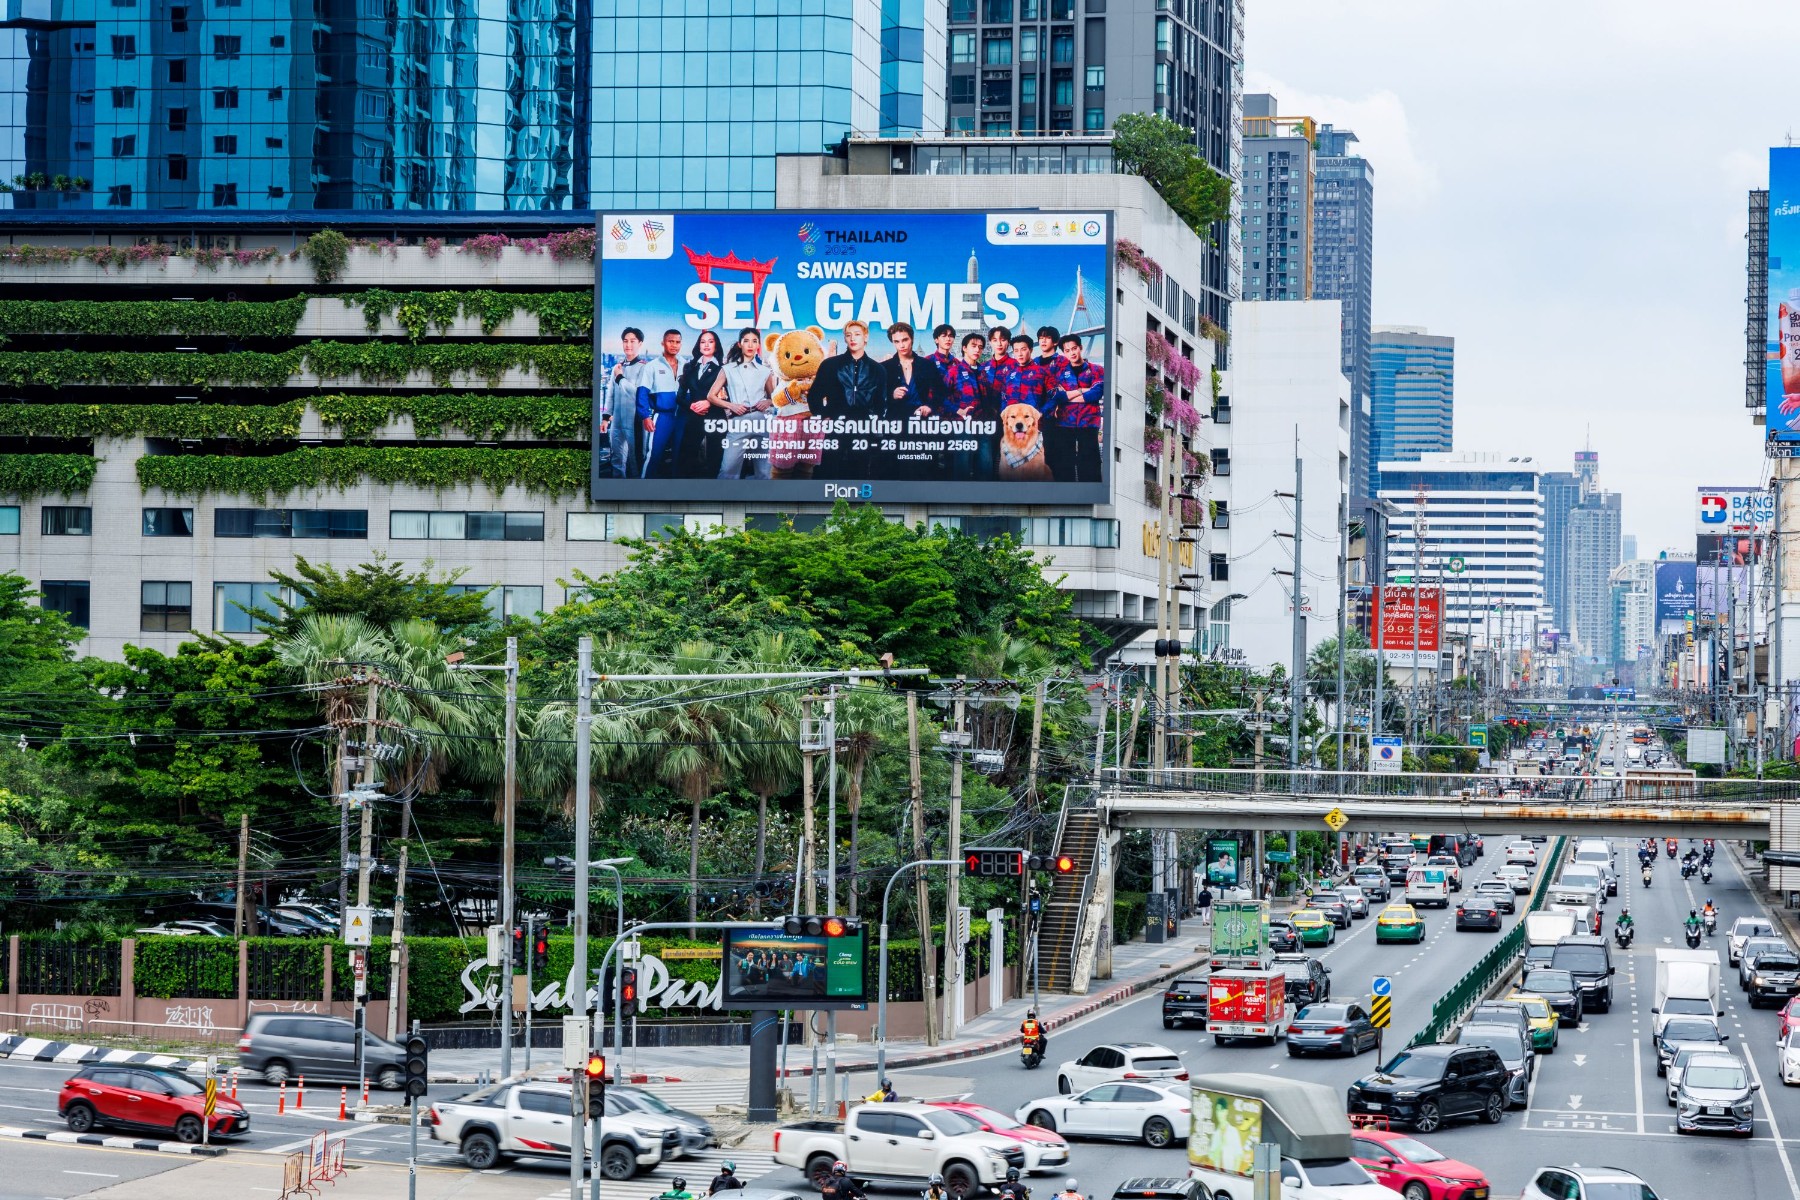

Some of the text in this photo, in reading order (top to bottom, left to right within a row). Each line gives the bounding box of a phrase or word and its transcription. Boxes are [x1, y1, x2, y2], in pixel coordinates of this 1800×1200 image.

[824, 230, 908, 243] THAILAND
[825, 245, 857, 255] 2025
[797, 262, 908, 279] SAWASDEE
[684, 282, 1020, 331] SEA GAMES
[703, 411, 996, 434] ชวนคนไทย เชียร์คนไทย ที่เมืองไทย
[721, 438, 729, 449] 9
[742, 439, 758, 450] 20
[761, 437, 805, 450] ธันวาคม
[808, 439, 839, 450] 2568
[852, 439, 868, 450] 20
[881, 439, 896, 450] 26
[899, 440, 945, 451] มกราคม
[947, 440, 978, 451] 2569
